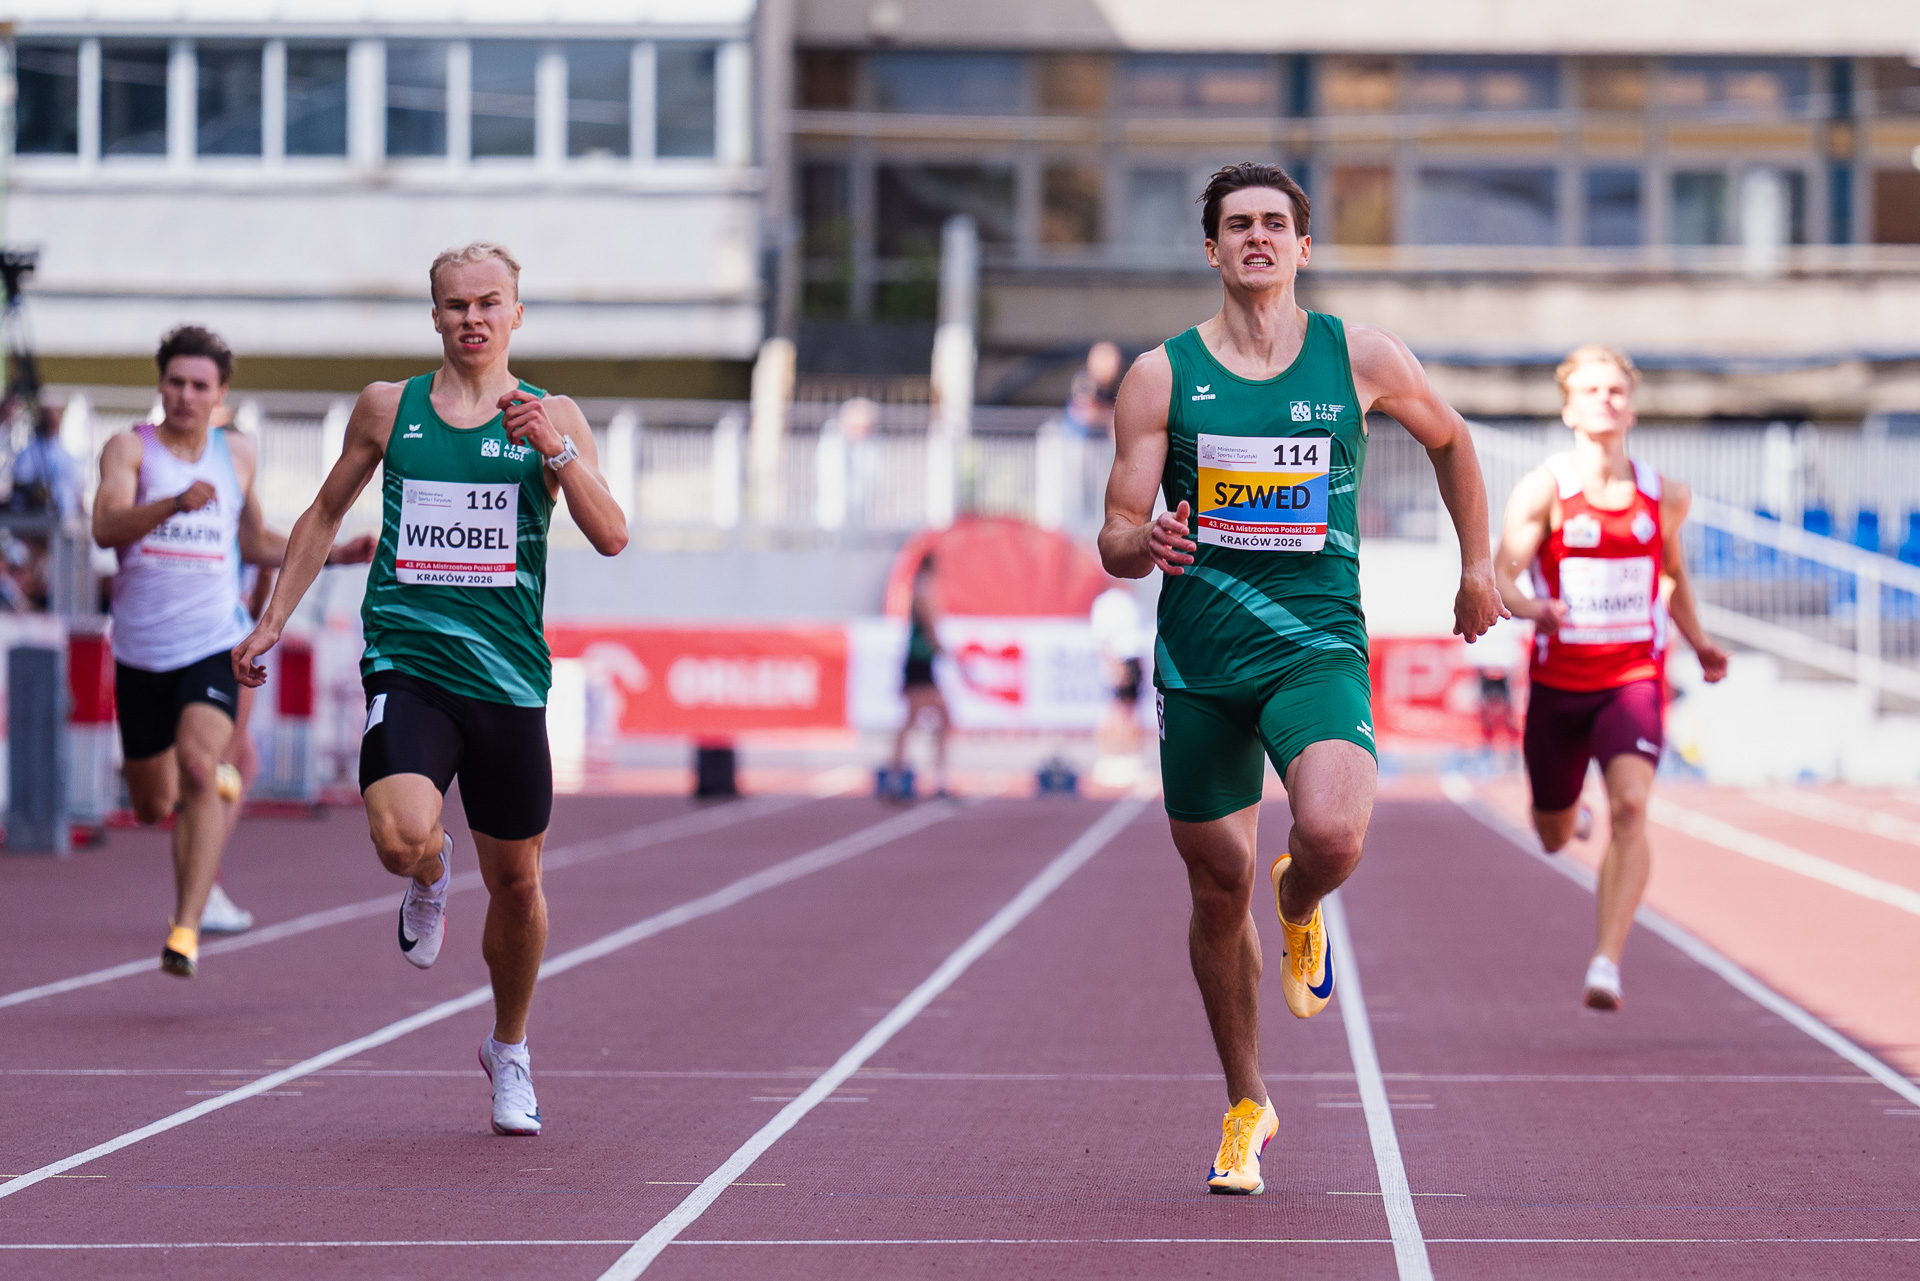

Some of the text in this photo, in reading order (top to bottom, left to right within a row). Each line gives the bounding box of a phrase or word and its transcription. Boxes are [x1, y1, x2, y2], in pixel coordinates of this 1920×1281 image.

[1192, 392, 1216, 401] erima
[1273, 444, 1318, 466] 114
[467, 490, 507, 510] 116
[1214, 482, 1310, 510] SZWED
[1219, 522, 1235, 531] PZLA
[1236, 525, 1279, 533] Mistrzostwa
[1280, 526, 1302, 534] Polski
[406, 522, 509, 550] WRÓBEL
[1220, 534, 1302, 547] KRAKÓW 2026
[432, 562, 472, 571] Mistrzostwa
[416, 573, 493, 584] KRAKÓW 2026
